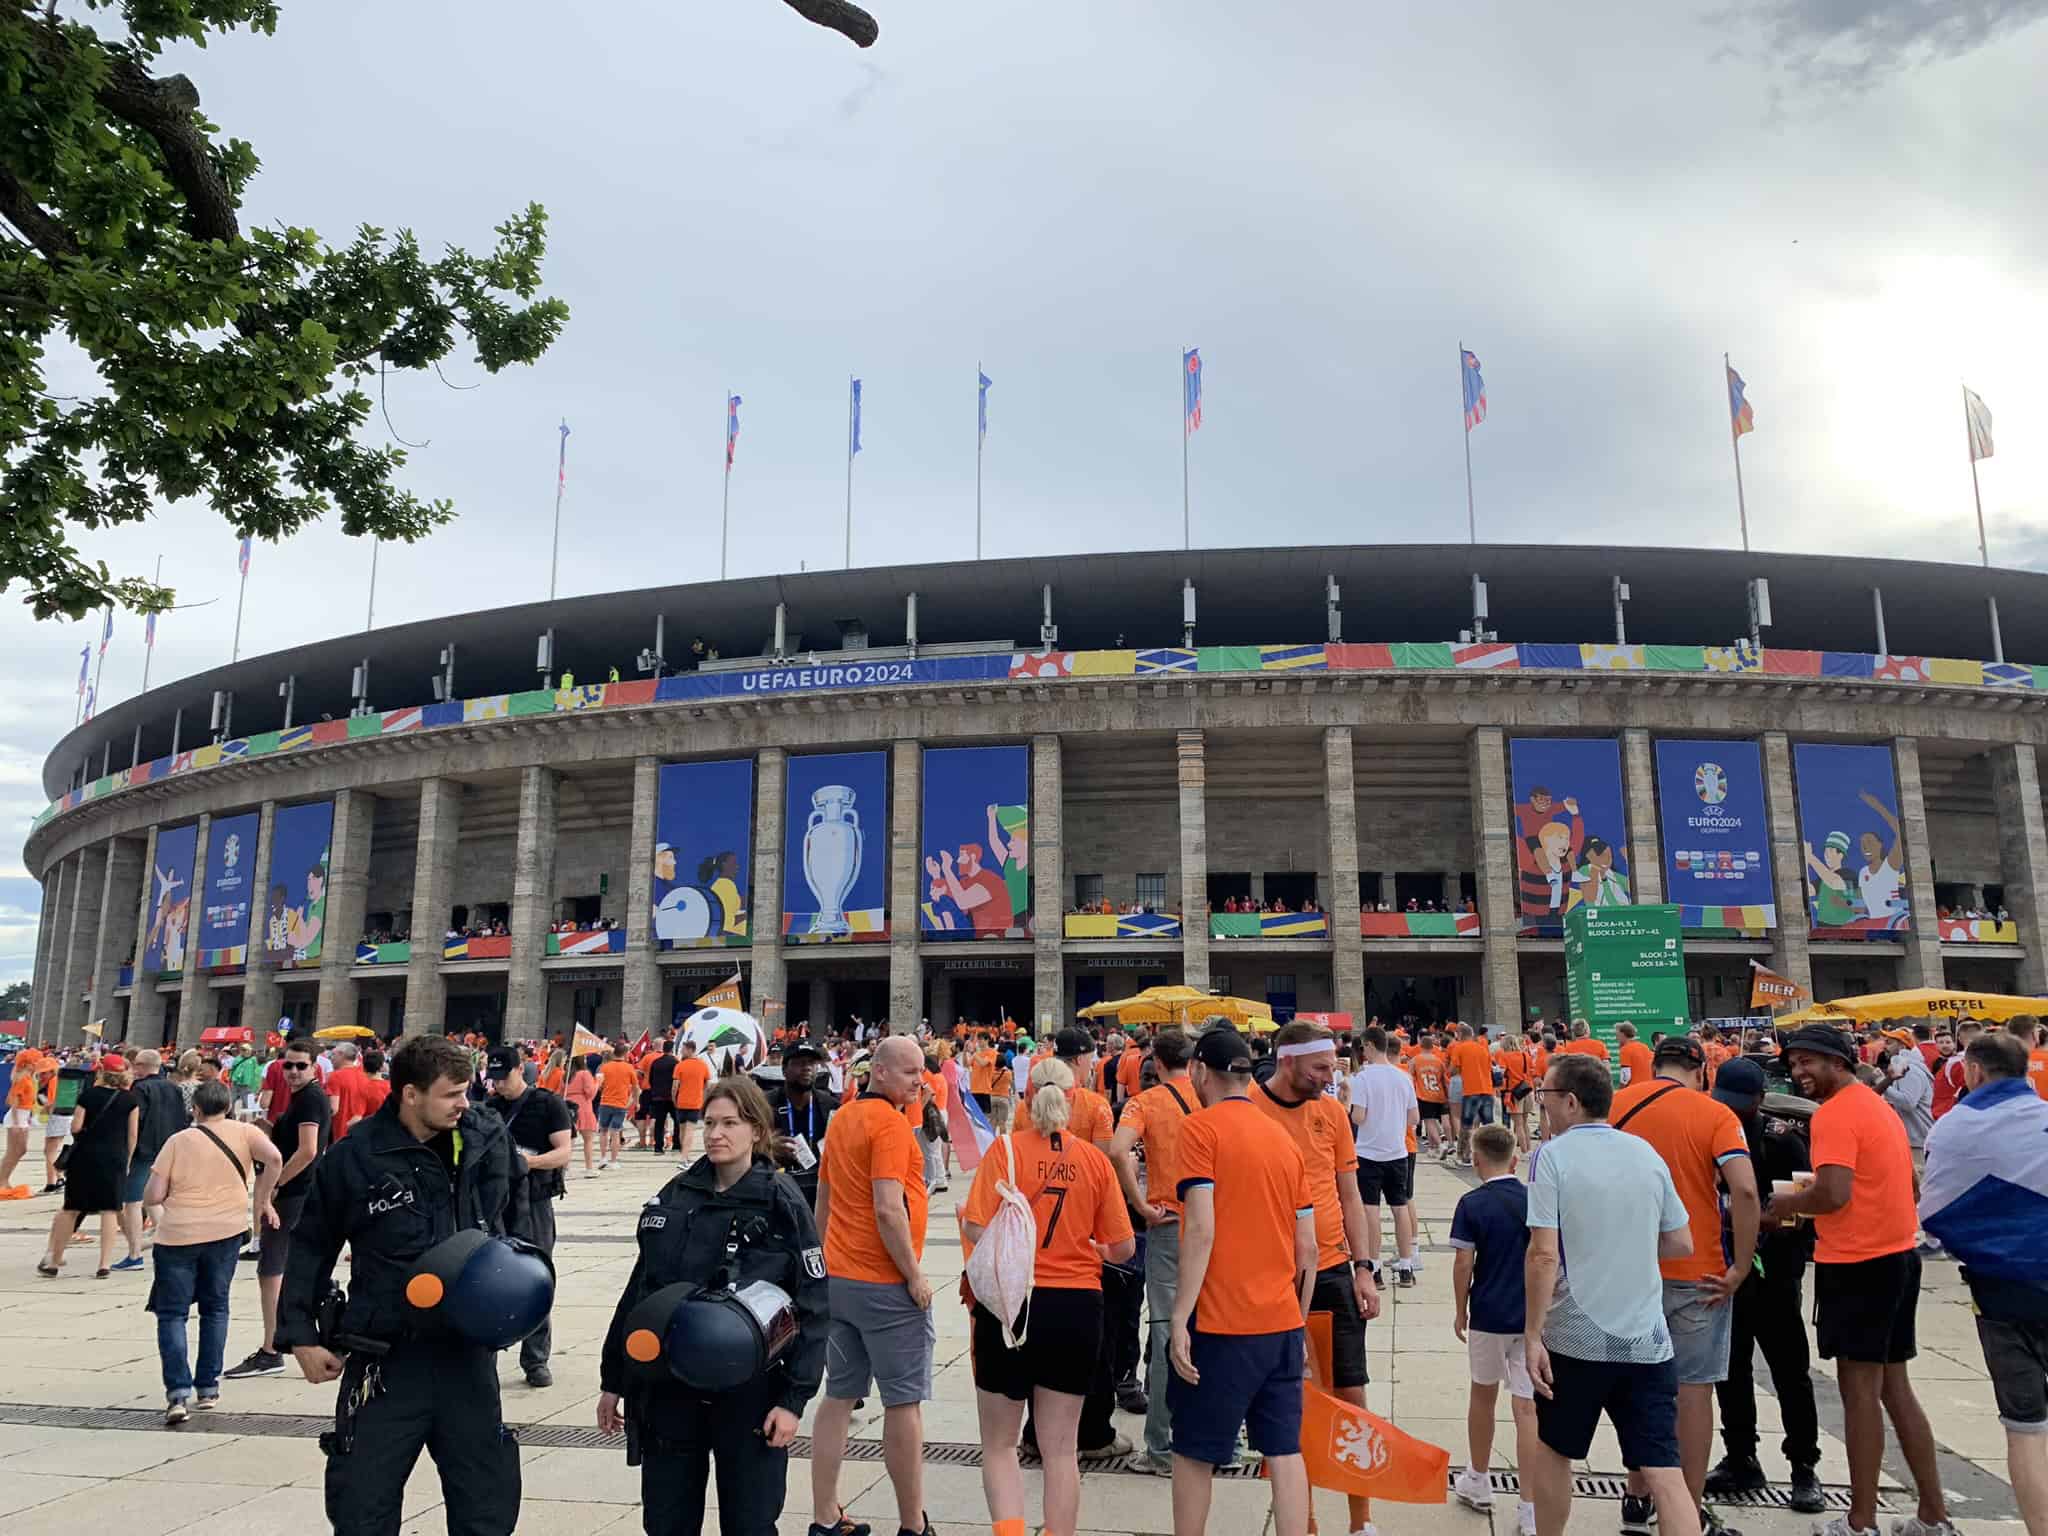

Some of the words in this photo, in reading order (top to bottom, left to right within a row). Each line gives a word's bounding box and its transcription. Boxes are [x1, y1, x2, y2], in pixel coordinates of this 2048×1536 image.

[1640, 951, 1662, 959] BLOCK
[1631, 960, 1654, 968] BLOCK
[1759, 982, 1794, 997] BIER
[1927, 999, 1985, 1012] BREZEL
[1041, 1185, 1068, 1249] 7
